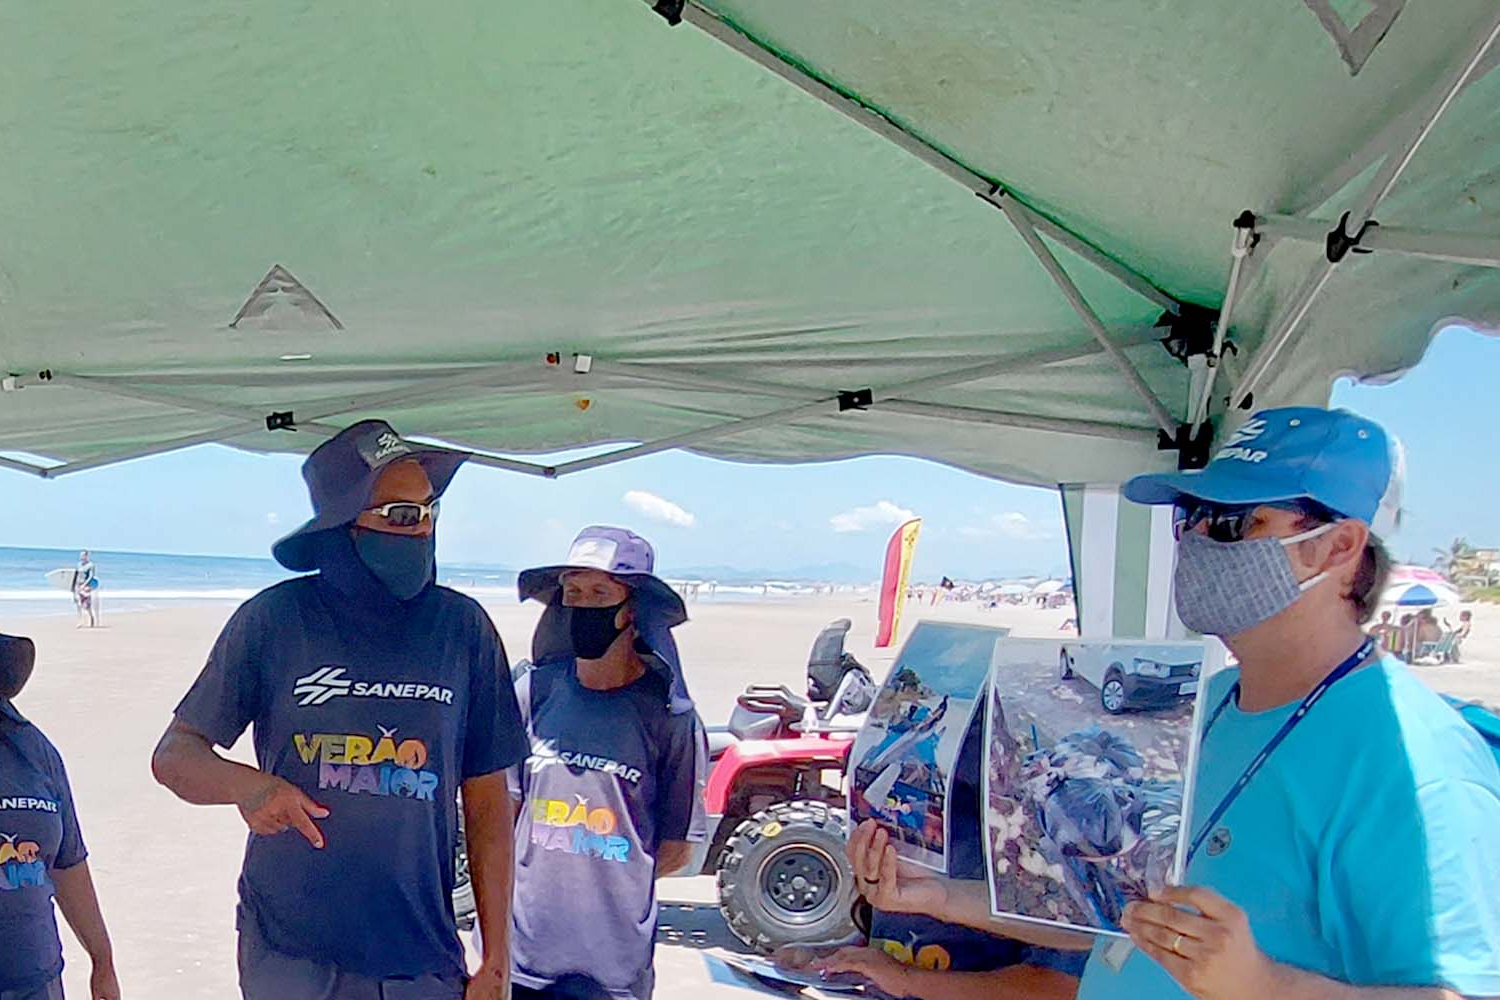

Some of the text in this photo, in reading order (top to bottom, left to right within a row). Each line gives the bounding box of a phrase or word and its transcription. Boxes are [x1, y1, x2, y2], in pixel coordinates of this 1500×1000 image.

[352, 682, 453, 705] SANEPAR
[293, 724, 427, 769] VERÃO
[317, 762, 438, 800] MAIOR
[560, 751, 642, 783] SANEPAR
[532, 794, 618, 835] ERÃO
